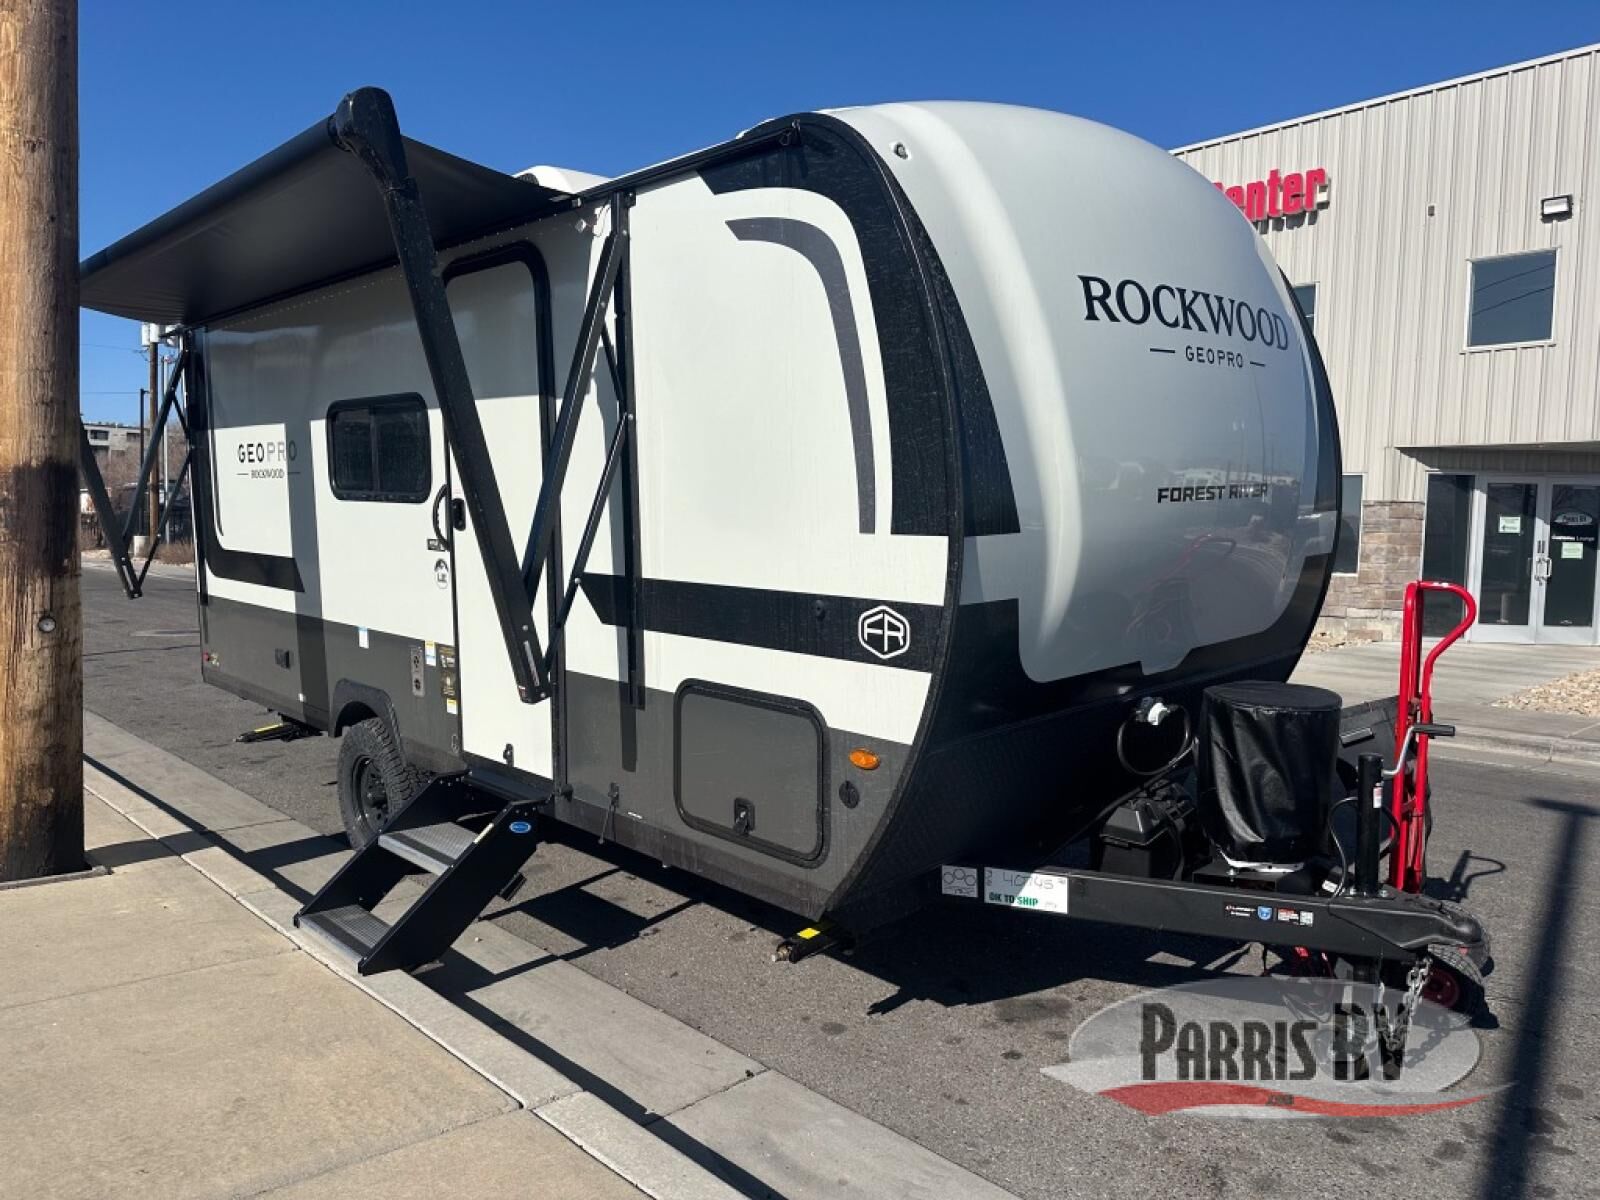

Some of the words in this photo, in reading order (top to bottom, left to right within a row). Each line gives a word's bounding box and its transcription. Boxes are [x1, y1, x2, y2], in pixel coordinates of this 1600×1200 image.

[1211, 168, 1326, 221] enter
[1078, 274, 1289, 350] ROCKWOOD
[1185, 345, 1244, 368] GEOPRO
[237, 440, 298, 463] GEOPRO
[1157, 485, 1226, 503] FOREST
[1017, 896, 1038, 907] SHIP
